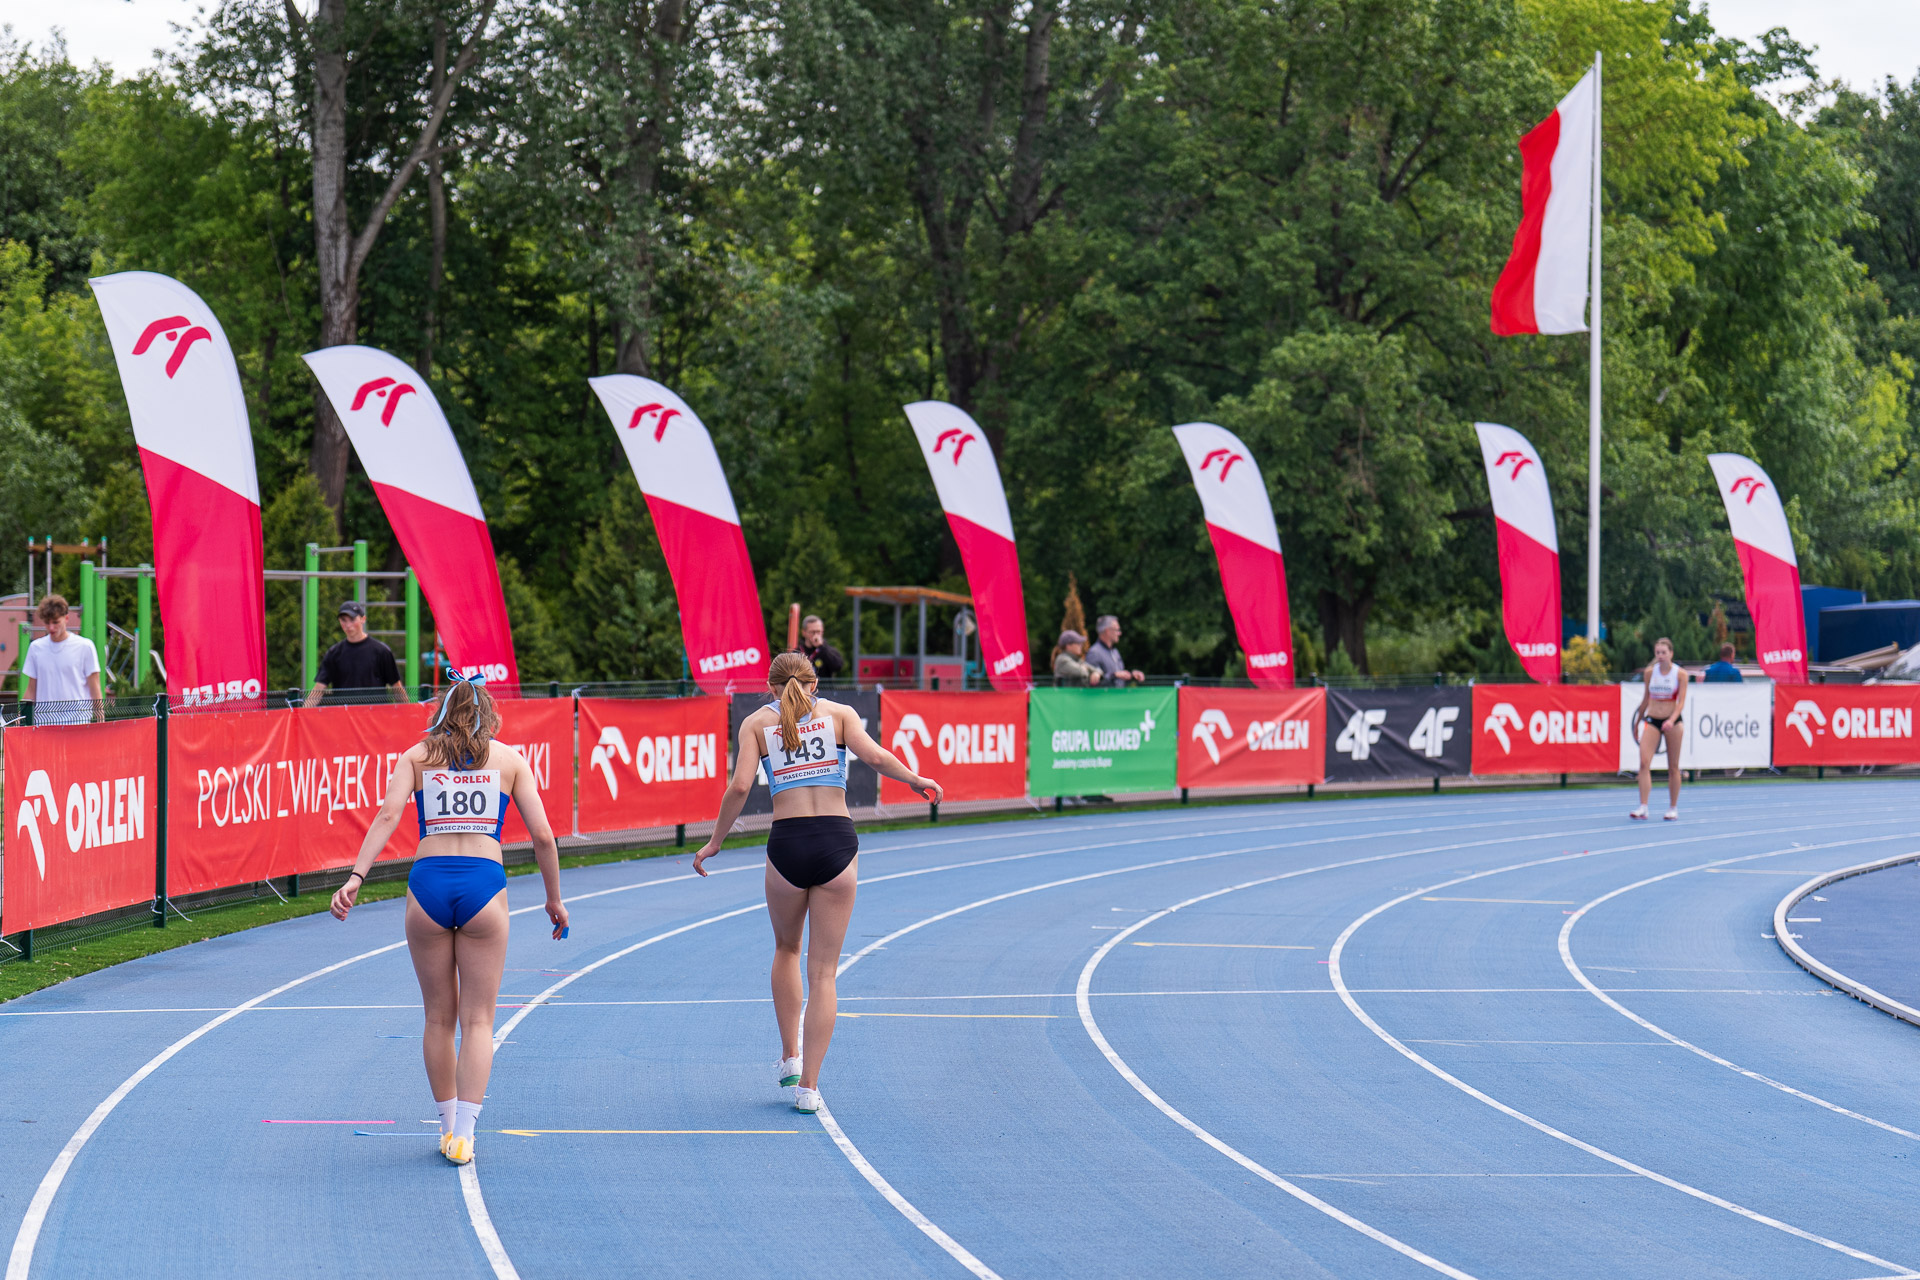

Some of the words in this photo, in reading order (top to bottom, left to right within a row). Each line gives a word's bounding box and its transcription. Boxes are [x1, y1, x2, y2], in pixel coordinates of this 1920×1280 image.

[1246, 720, 1309, 751] ORLEN
[1335, 709, 1387, 761] 4F
[1409, 706, 1460, 758] 4F
[1528, 710, 1609, 745] ORLEN
[1699, 713, 1760, 744] Okęcie
[1832, 706, 1912, 739] ORLEN
[779, 736, 826, 767] 143
[937, 723, 1015, 766] ORLEN
[1051, 729, 1091, 753] GRUPA
[1093, 728, 1141, 752] LUXMED
[636, 733, 716, 784] ORLEN
[782, 770, 816, 781] PIASECZNO
[816, 767, 831, 775] 2026
[197, 763, 271, 829] POLSKI
[276, 754, 370, 825] ZWIĄZEK
[452, 775, 491, 784] ORLEN
[65, 775, 145, 853] ORLEN
[436, 790, 487, 816] 180
